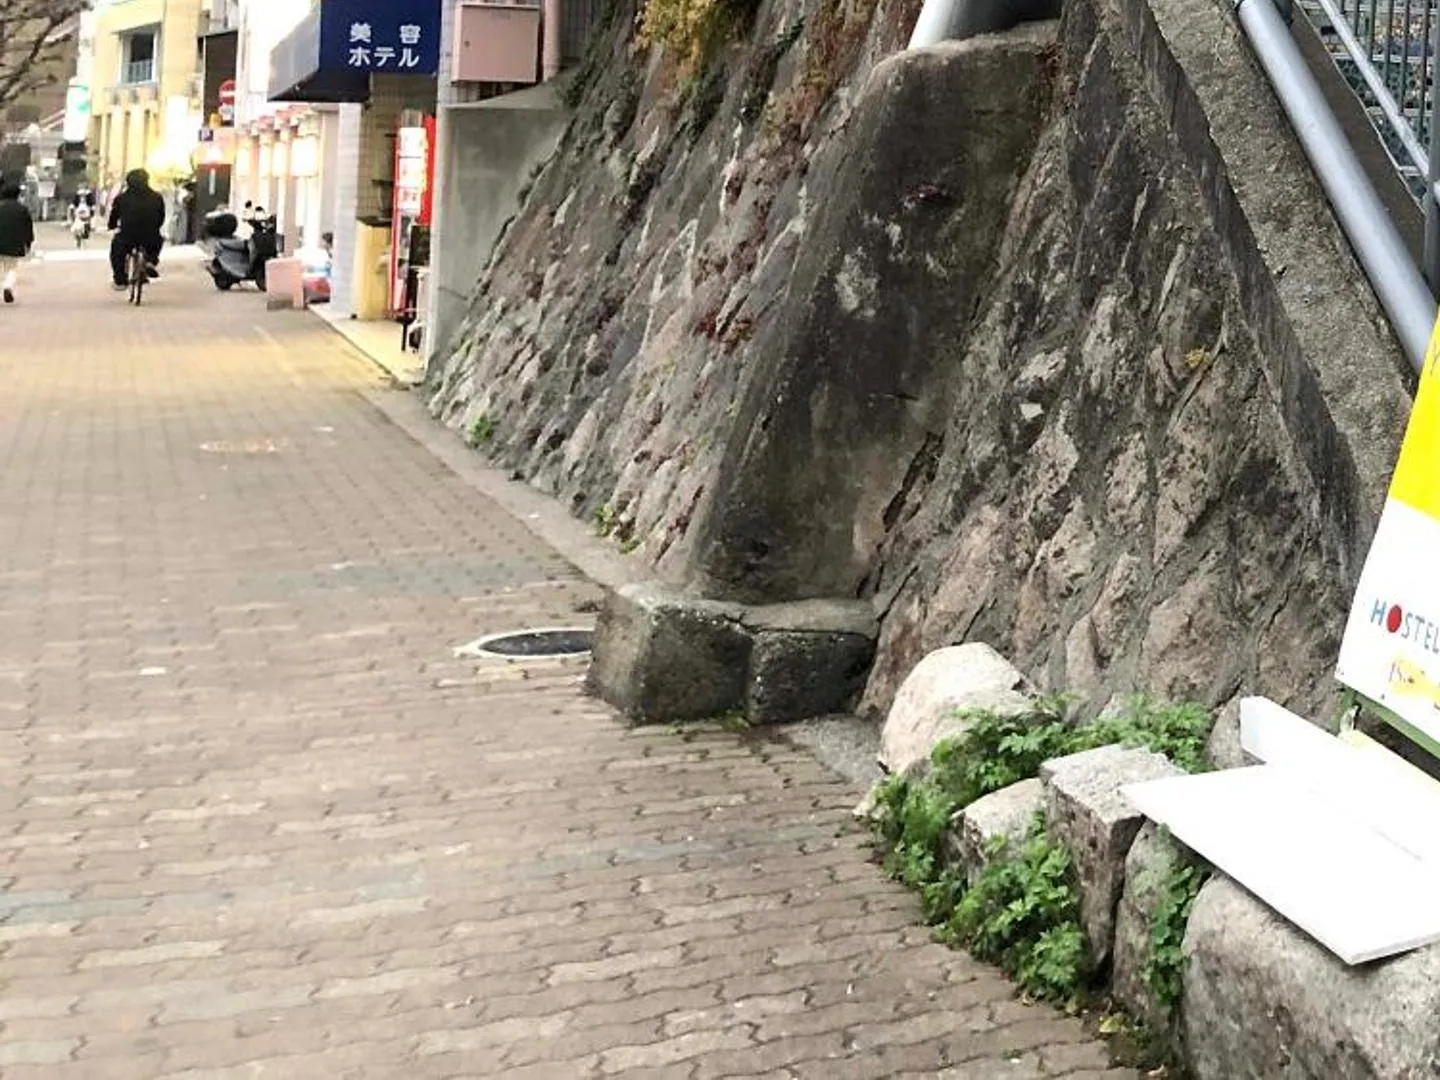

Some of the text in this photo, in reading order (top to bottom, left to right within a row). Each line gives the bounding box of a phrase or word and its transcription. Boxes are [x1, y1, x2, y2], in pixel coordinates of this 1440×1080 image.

[348, 46, 420, 68] ホテル
[1370, 597, 1440, 654] HOSTEL
